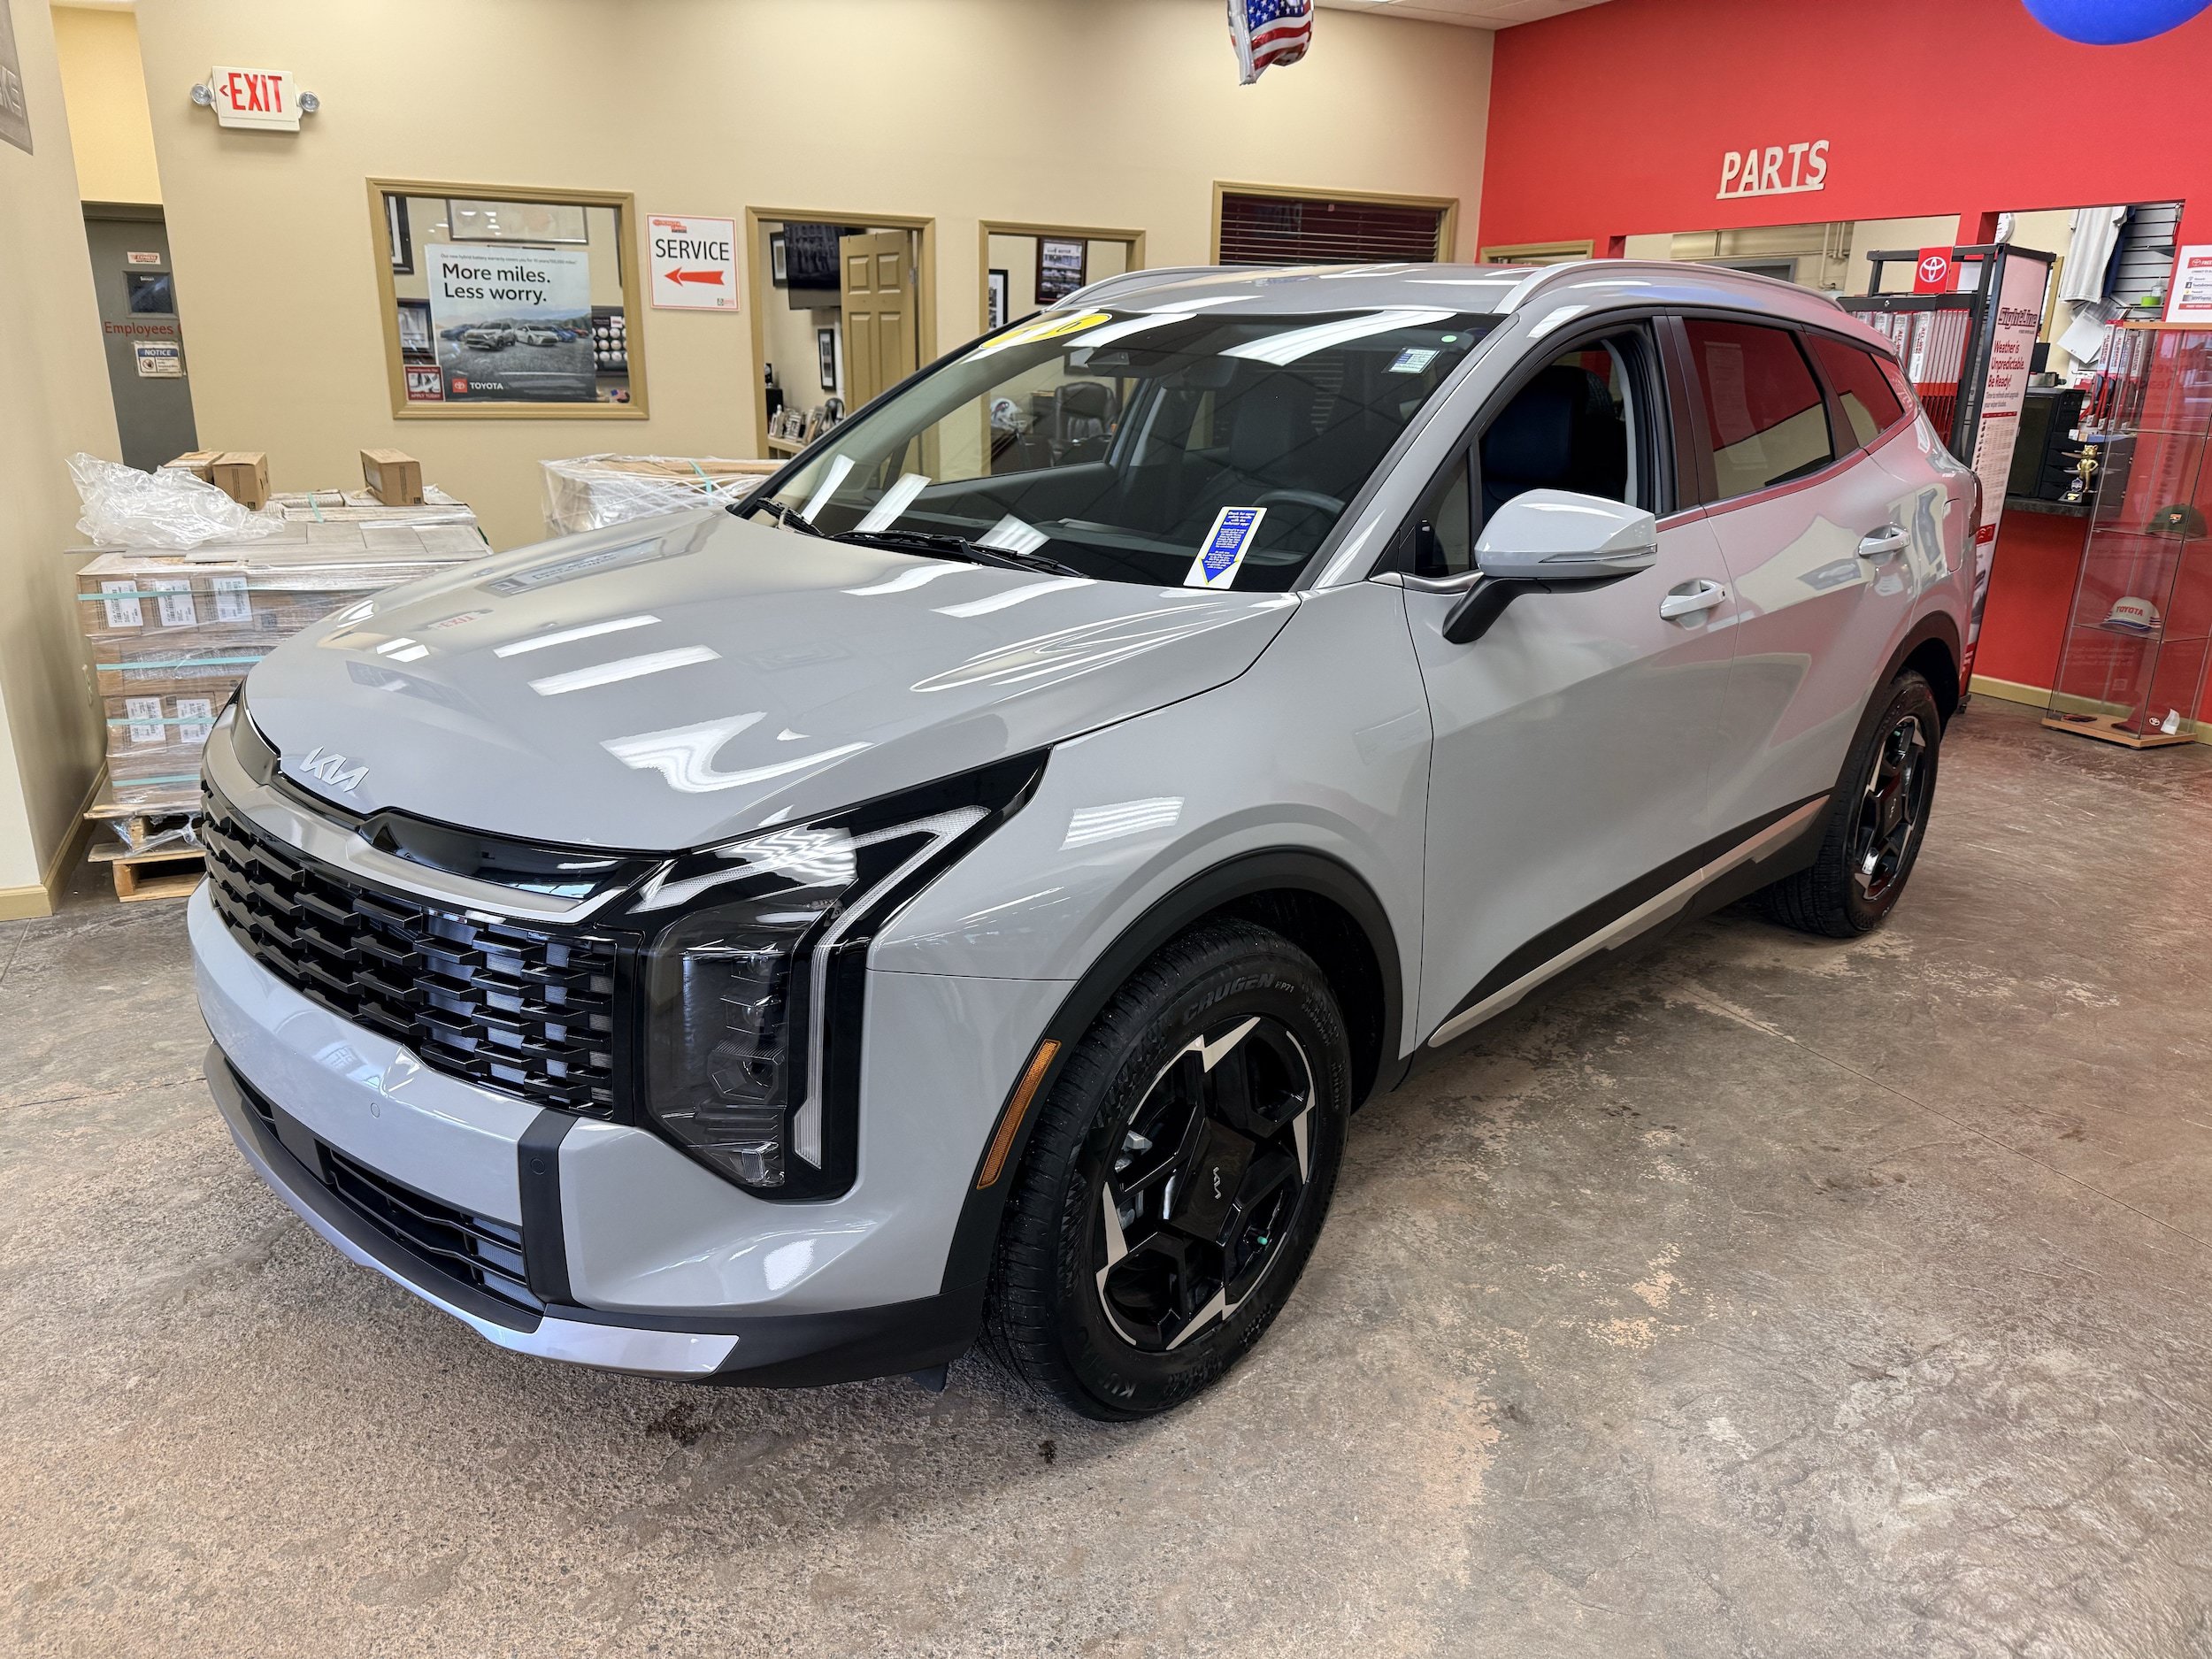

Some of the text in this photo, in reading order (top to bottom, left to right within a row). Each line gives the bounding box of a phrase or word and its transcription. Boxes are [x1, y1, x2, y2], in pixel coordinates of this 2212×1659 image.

[227, 72, 282, 113] EXIT
[1719, 139, 1830, 194] PARTS
[655, 238, 730, 261] SERVICE
[442, 263, 551, 283] More miles.
[444, 282, 548, 305] Less worry.
[104, 321, 174, 337] Employees
[1993, 340, 2020, 354] Weather is
[1991, 357, 2024, 373] Unpredictable.
[469, 381, 503, 390] TOYOTA
[1987, 374, 1994, 388] Be
[2116, 605, 2144, 617] TOYOTA
[1182, 972, 1276, 1025] CRUGEN
